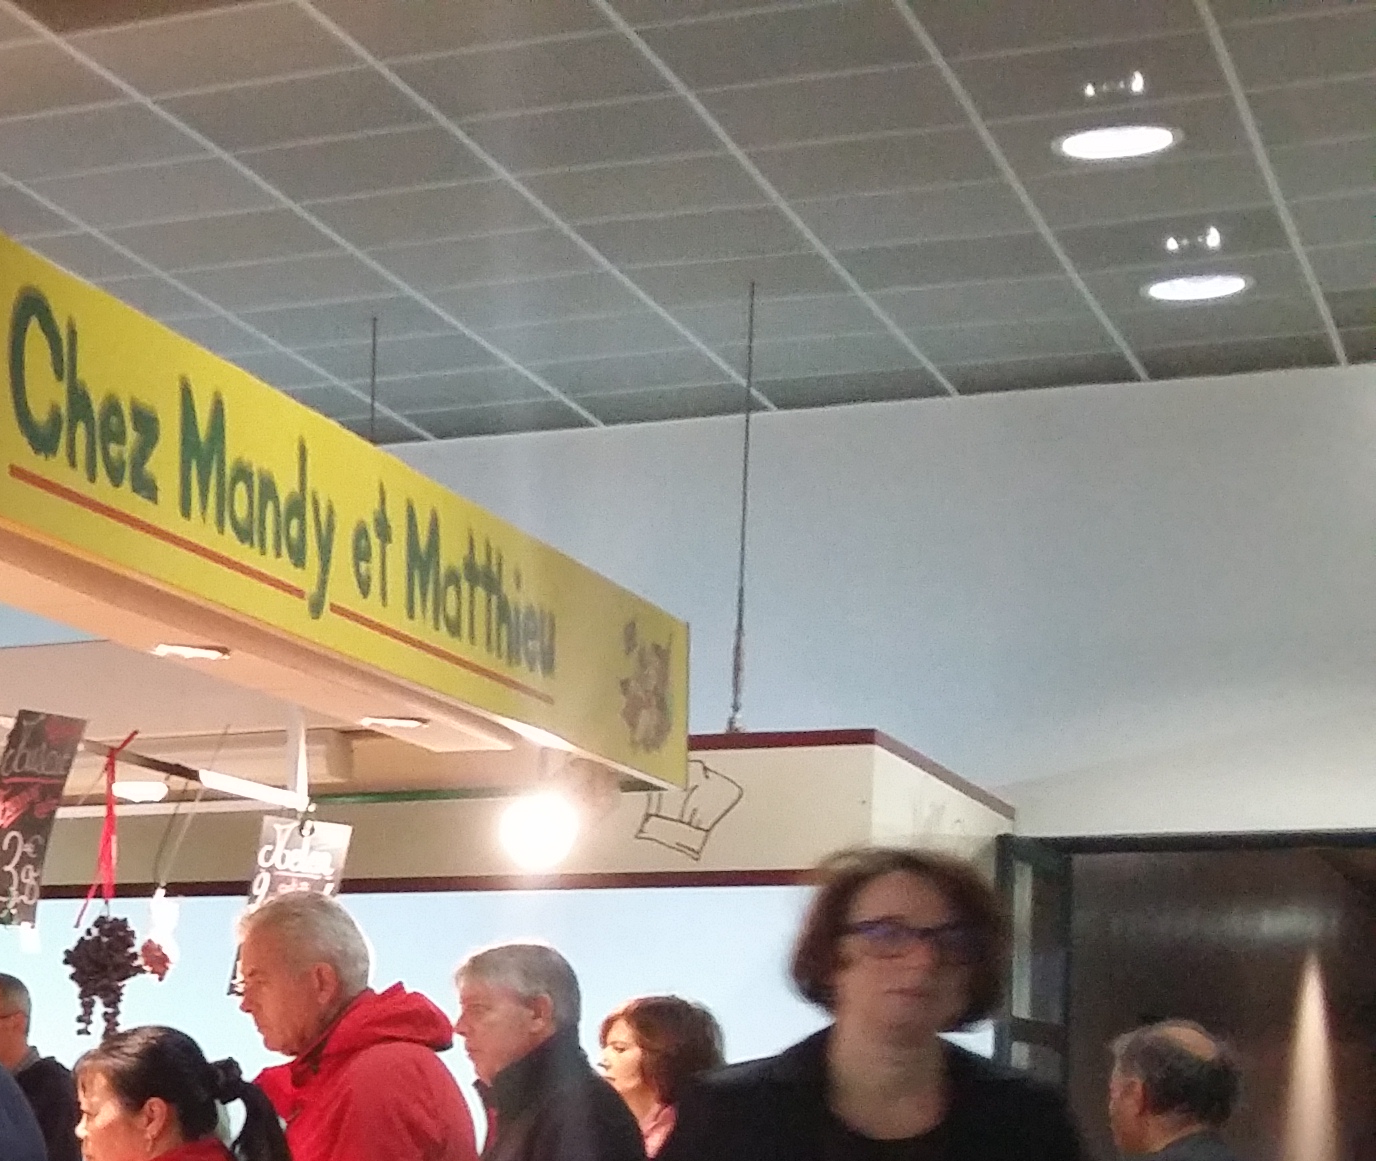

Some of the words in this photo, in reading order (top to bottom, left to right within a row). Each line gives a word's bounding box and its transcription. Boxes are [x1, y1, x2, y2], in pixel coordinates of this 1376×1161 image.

[9, 284, 159, 504] Chez
[179, 374, 336, 620] Mandy
[353, 482, 393, 607] et
[405, 497, 557, 678] Matthieu
